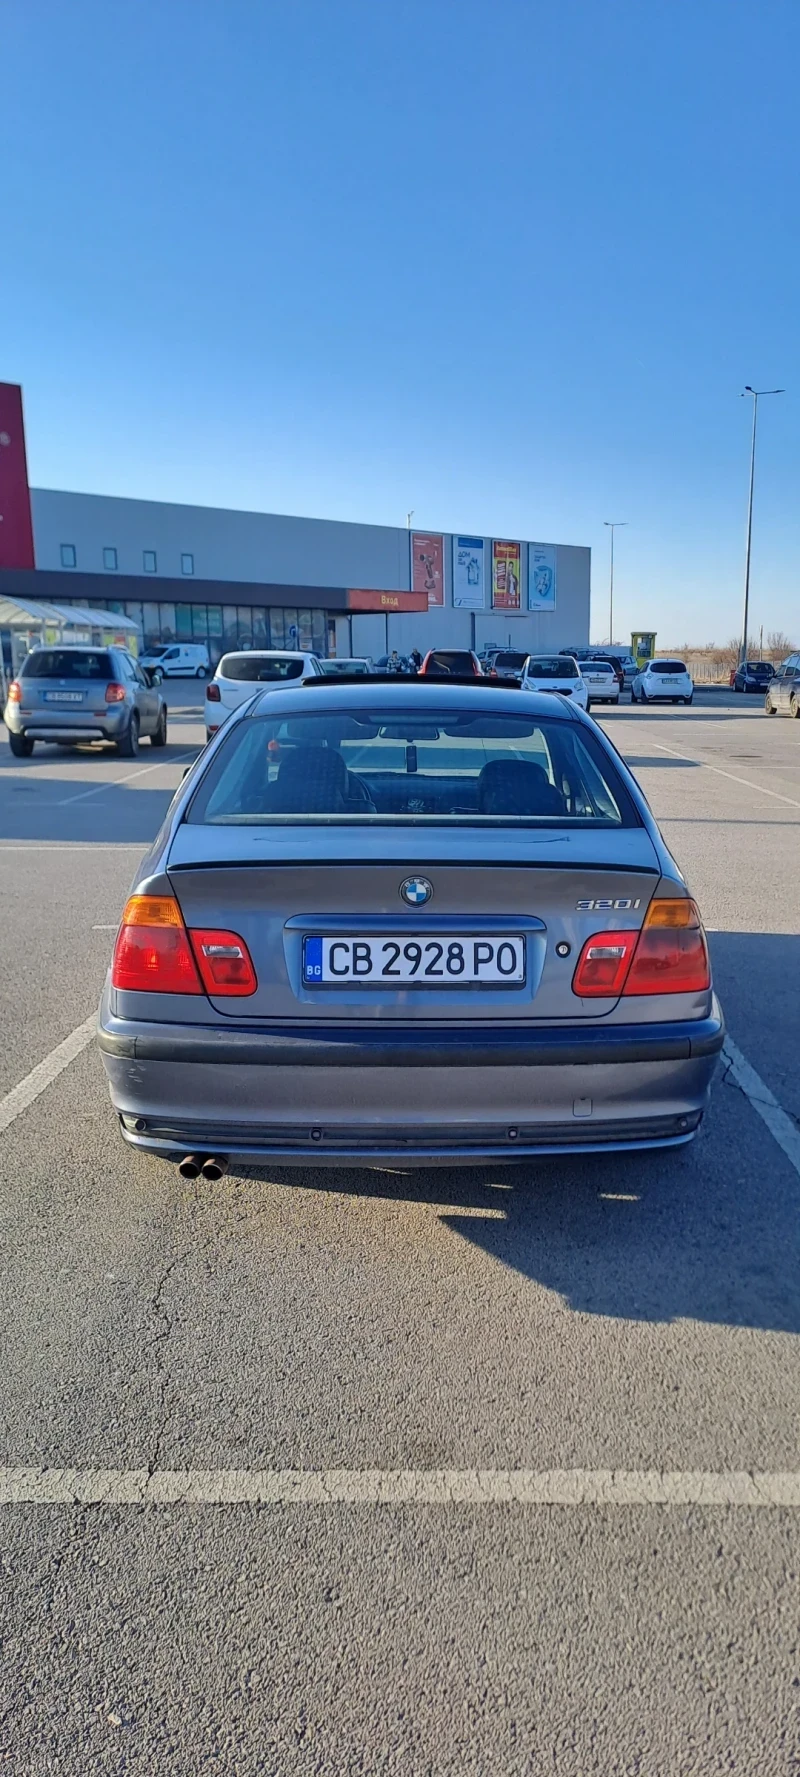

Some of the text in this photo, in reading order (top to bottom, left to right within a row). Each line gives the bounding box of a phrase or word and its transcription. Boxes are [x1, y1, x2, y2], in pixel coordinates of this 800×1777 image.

[381, 595, 399, 606] Вход
[329, 942, 517, 976] CB 2928 PO
[306, 965, 321, 975] BG
